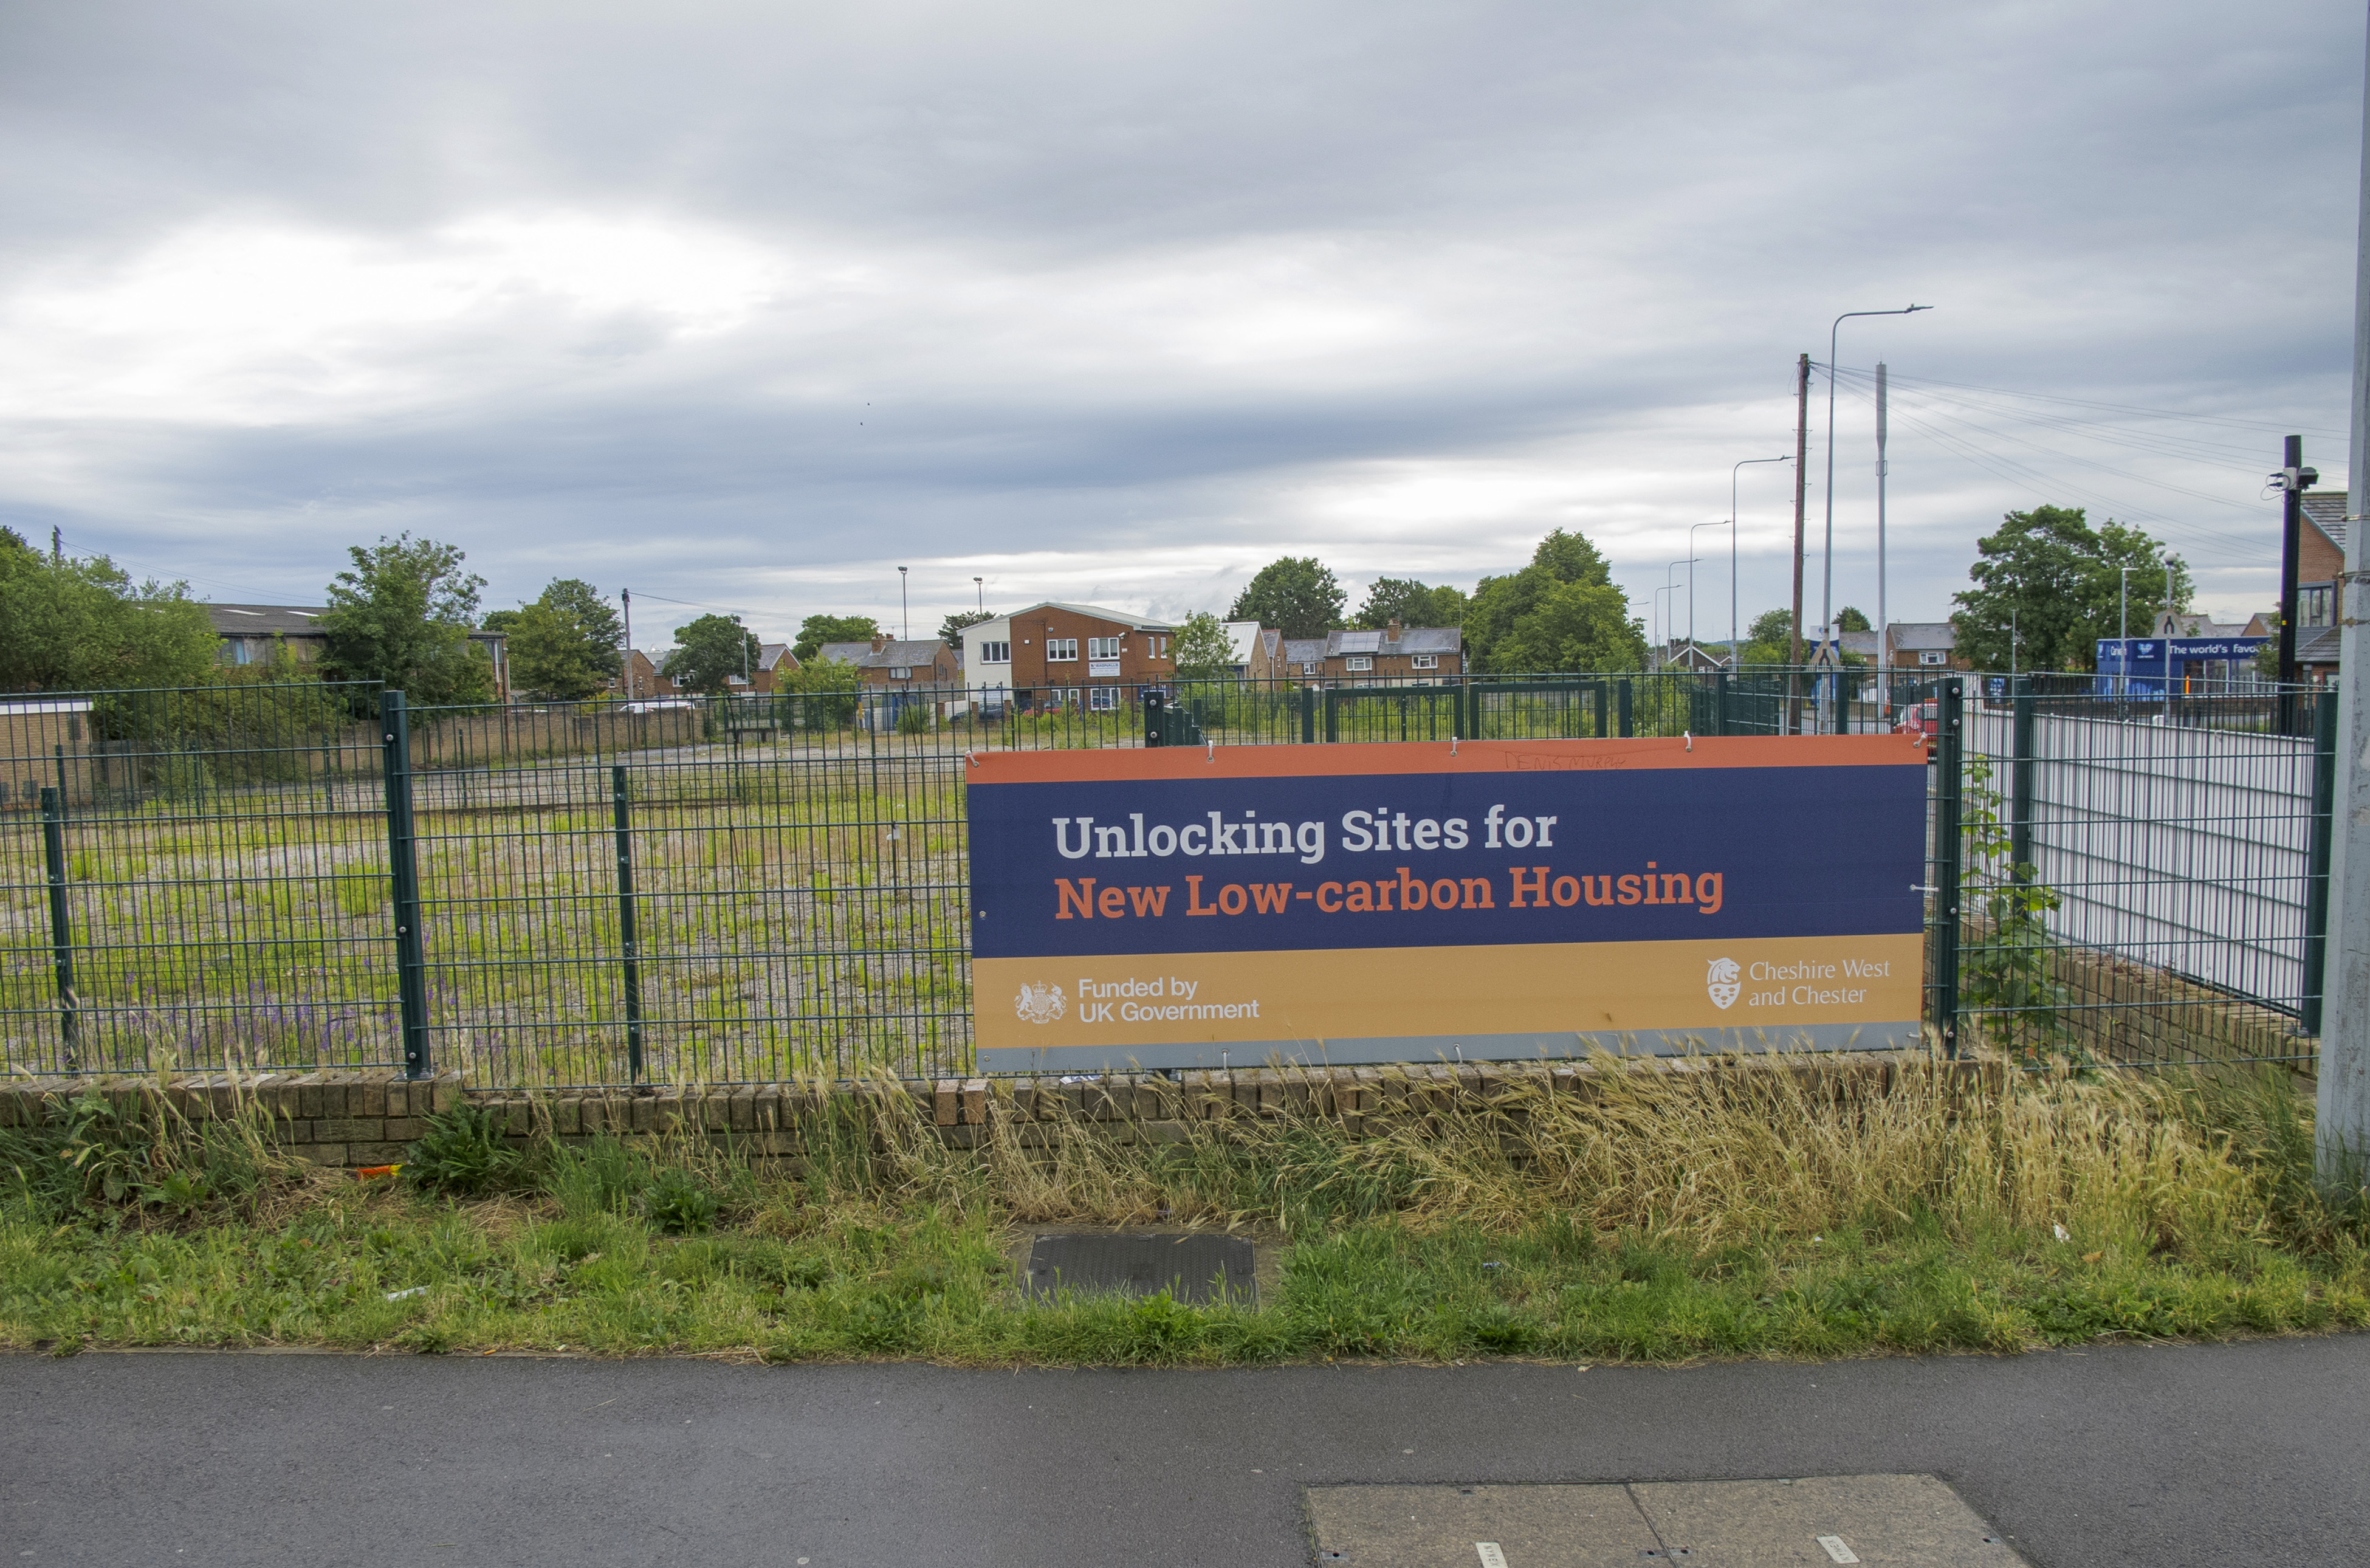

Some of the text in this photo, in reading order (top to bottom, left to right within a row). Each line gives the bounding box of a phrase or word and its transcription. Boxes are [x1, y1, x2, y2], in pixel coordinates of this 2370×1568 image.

[2169, 645, 2186, 654] The
[2189, 644, 2228, 653] world's
[1505, 751, 1561, 770] DENIS
[1052, 804, 1557, 864] Unlocking Sites for
[1054, 862, 1722, 920] New Low-carbon Housing
[1749, 959, 1891, 981] Cheshire West
[1078, 977, 1198, 1000] Funded by
[1748, 985, 1867, 1006] and Chester
[1079, 999, 1260, 1023] UK Government
[1483, 1545, 1500, 1566] NYNEX
